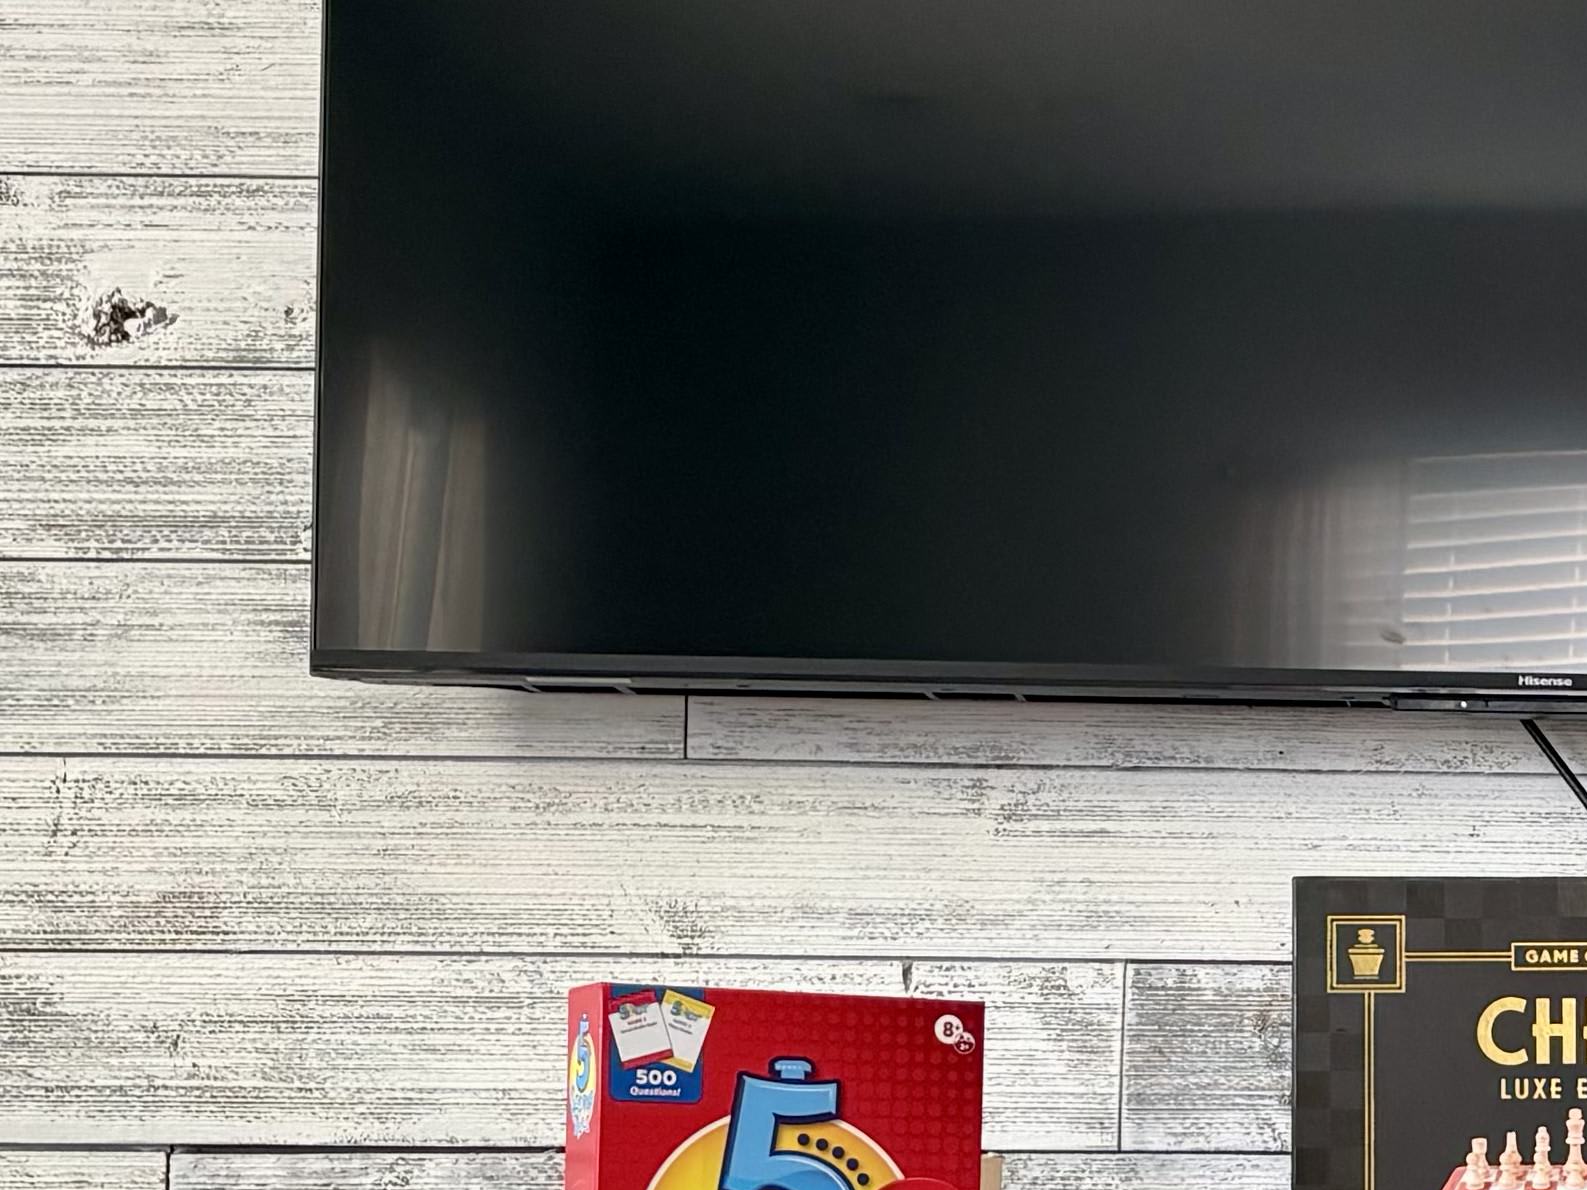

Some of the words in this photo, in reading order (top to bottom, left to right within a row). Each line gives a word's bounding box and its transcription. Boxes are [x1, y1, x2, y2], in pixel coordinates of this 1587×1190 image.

[1517, 675, 1573, 687] Hisense
[1525, 949, 1579, 965] GAME
[635, 1069, 677, 1086] 500
[630, 1086, 682, 1097] Questions!
[1500, 1077, 1563, 1100] LUXE
